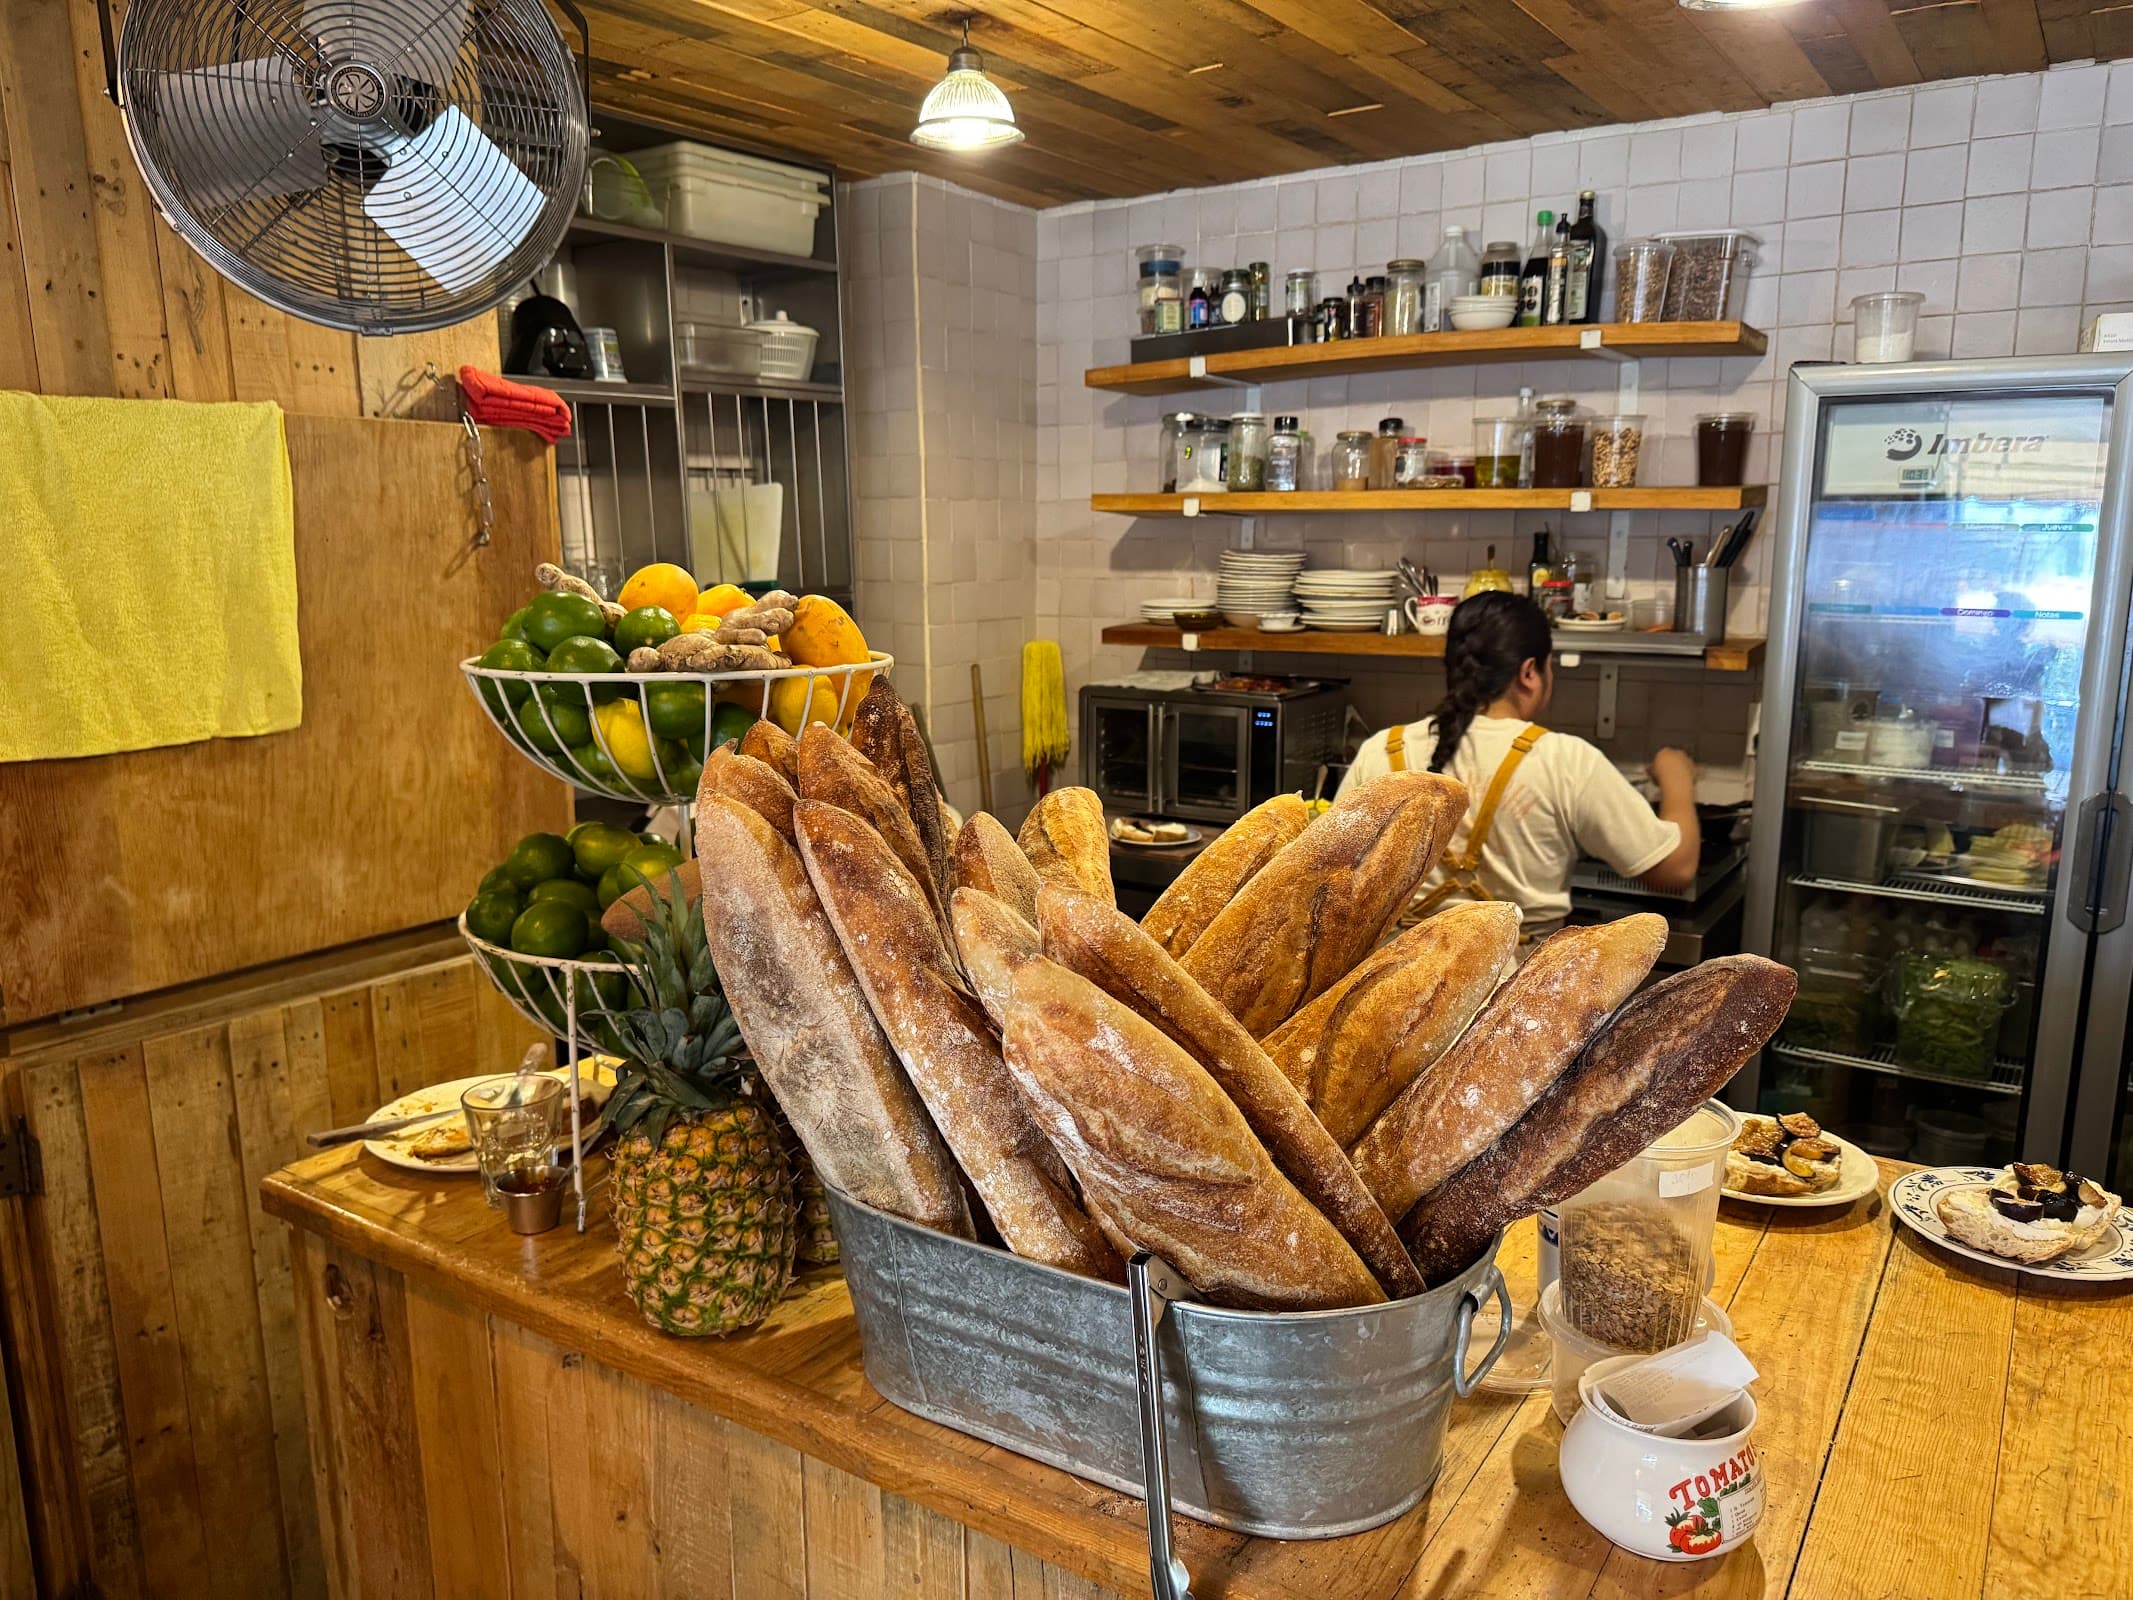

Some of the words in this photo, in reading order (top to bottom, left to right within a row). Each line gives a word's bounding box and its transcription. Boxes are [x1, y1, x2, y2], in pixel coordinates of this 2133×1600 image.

[1928, 432, 2045, 455] Imbera
[2041, 523, 2073, 532] Jueves
[2034, 610, 2060, 619] Notas
[1669, 1437, 1757, 1511] TOMATO
